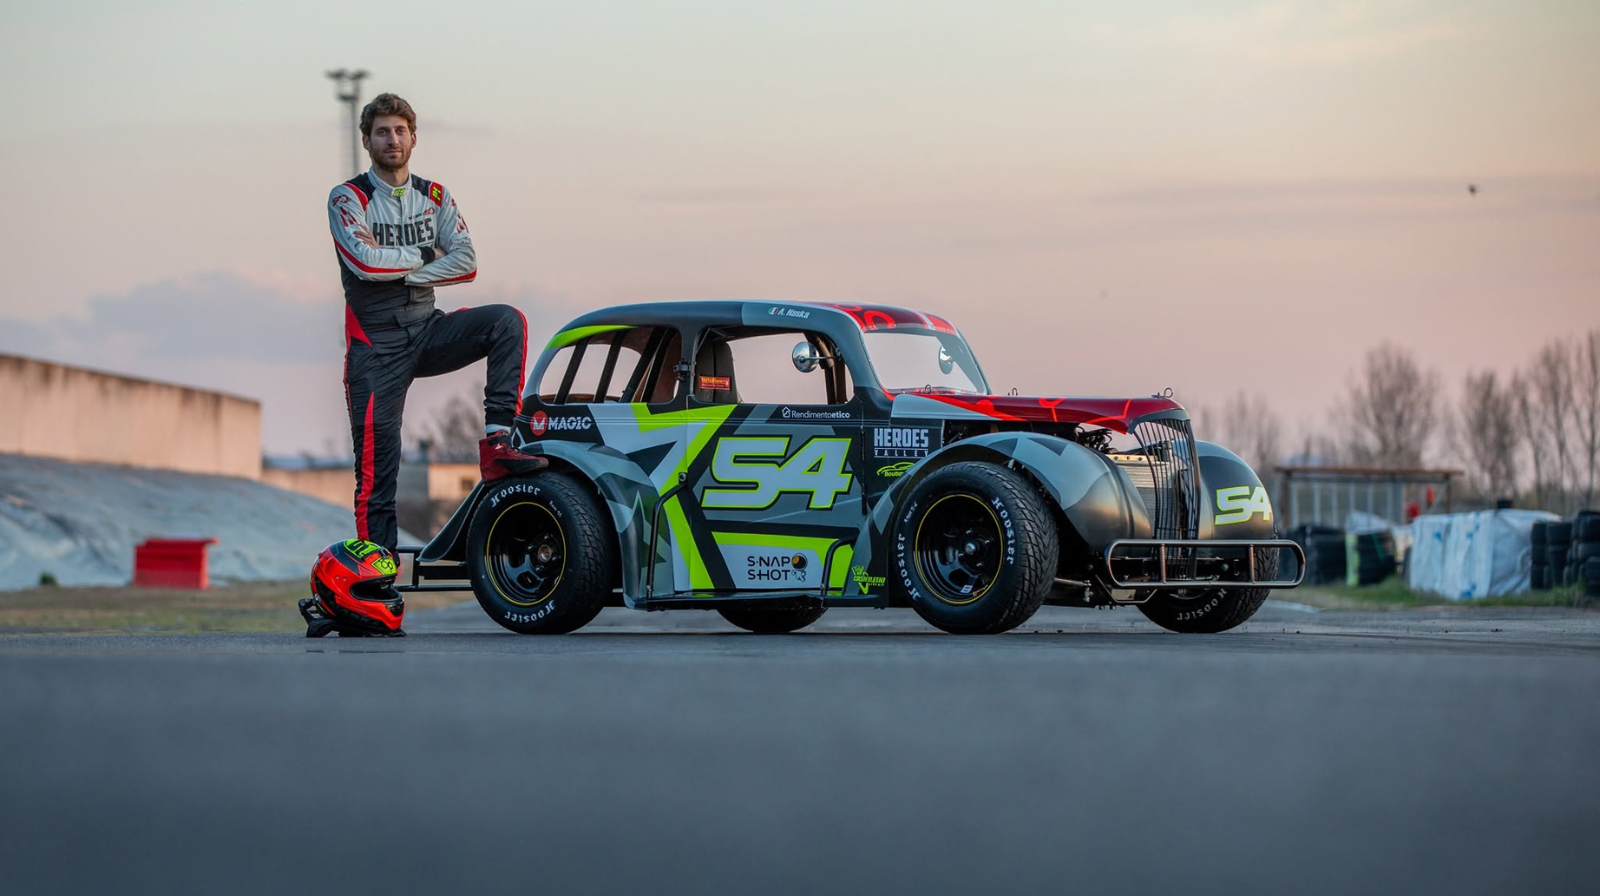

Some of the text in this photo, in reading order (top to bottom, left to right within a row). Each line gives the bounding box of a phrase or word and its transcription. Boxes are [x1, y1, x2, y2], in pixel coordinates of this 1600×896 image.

[372, 218, 434, 246] HEROES
[548, 416, 592, 430] MAGIC
[791, 410, 850, 418] Rendimentoetico
[874, 428, 929, 448] HEROES
[874, 449, 928, 457] VALLEY
[701, 437, 853, 509] 54
[490, 484, 541, 508] Hoosier
[1214, 485, 1272, 525] 54
[991, 497, 1016, 565] Hoosier
[747, 569, 791, 581] SHOT
[897, 533, 922, 601] Hoosier
[504, 600, 555, 623] Hoosier
[1176, 588, 1227, 621] Hoosier
